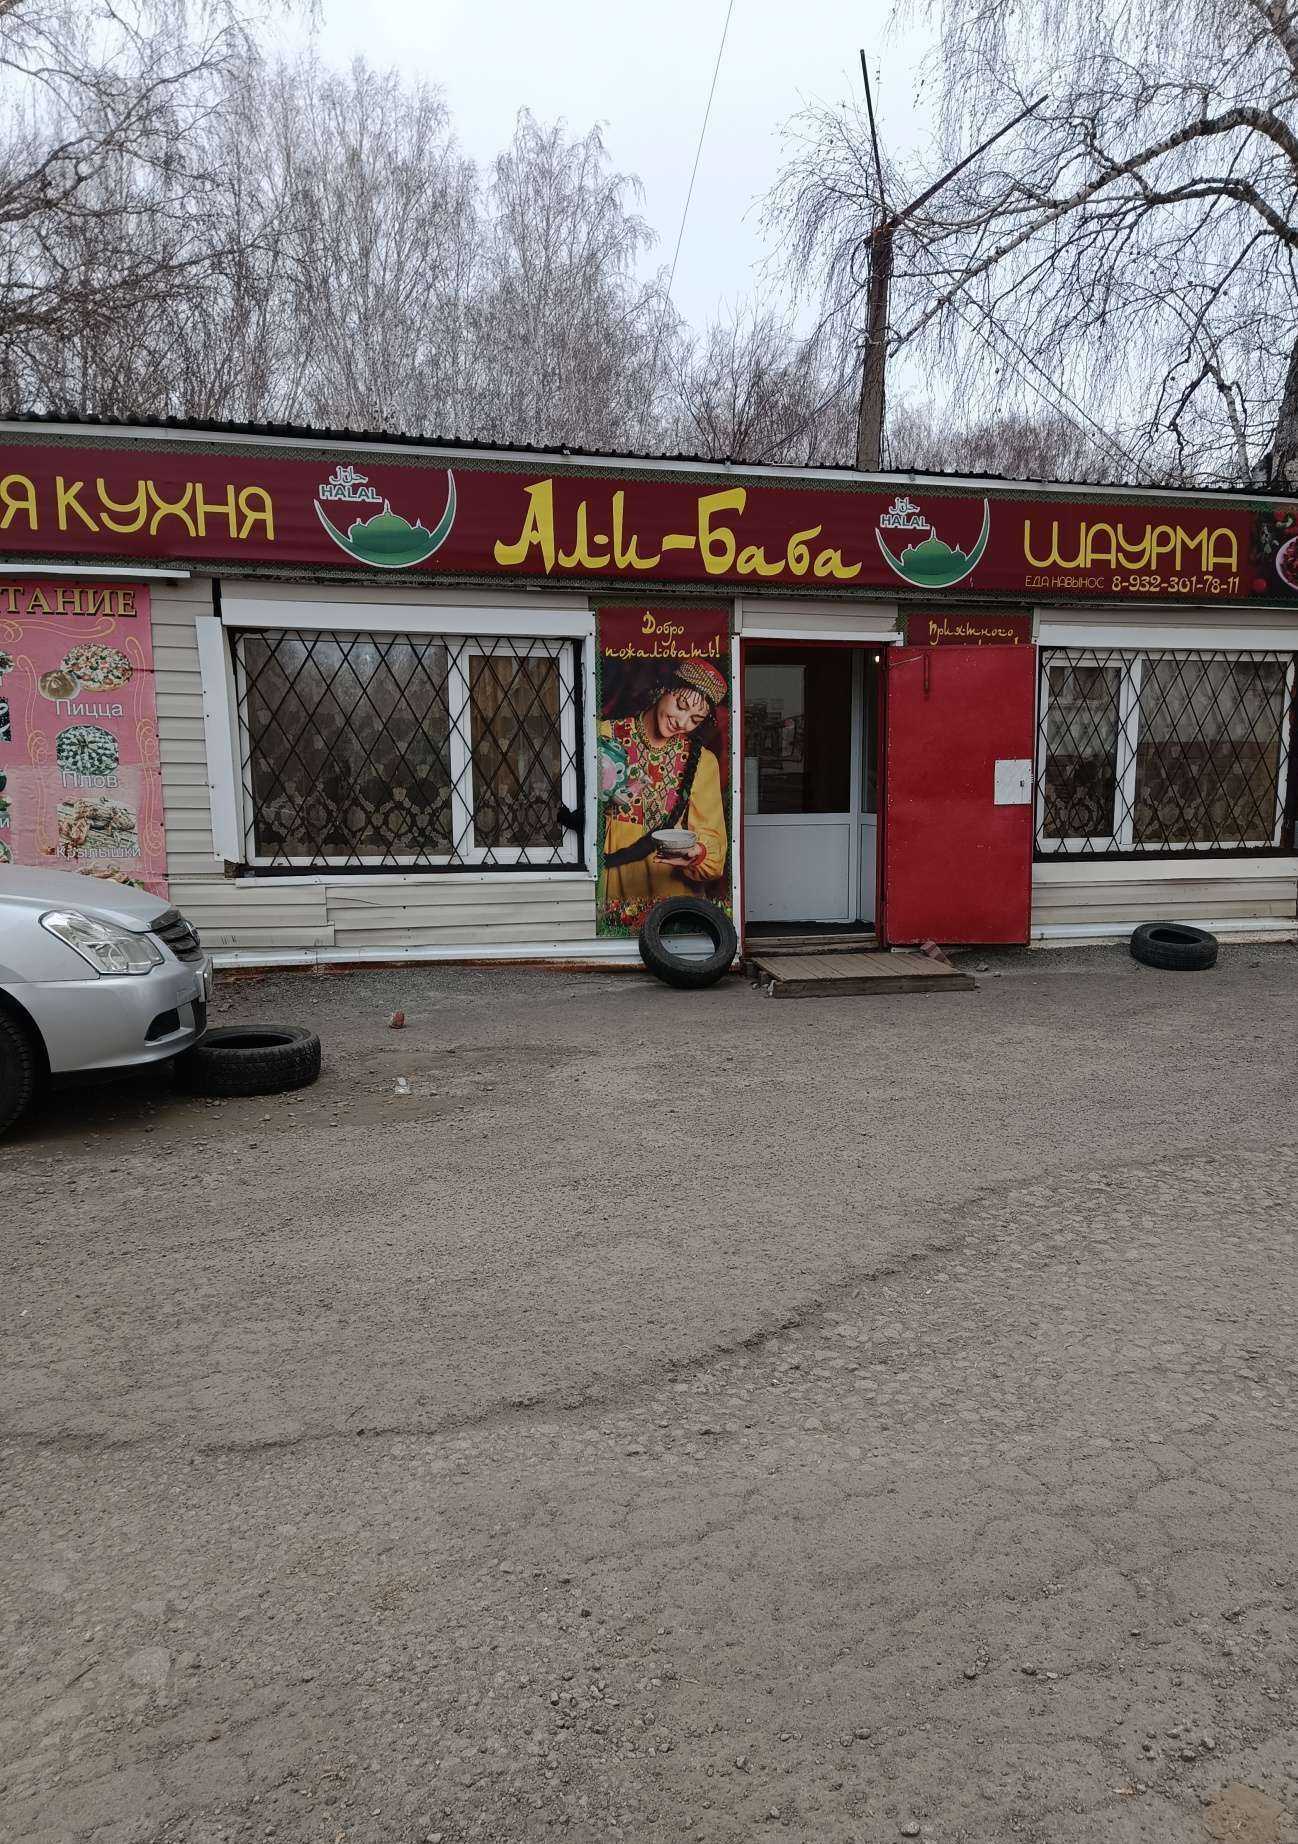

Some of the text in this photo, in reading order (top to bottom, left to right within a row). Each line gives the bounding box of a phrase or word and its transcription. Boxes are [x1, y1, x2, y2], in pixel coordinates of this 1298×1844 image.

[319, 484, 383, 503] HALAL
[55, 475, 276, 541] КУХНЯ
[493, 478, 863, 580] Али-Баба
[880, 513, 931, 530] HALAL
[1024, 519, 1238, 572] ШАУРМА
[1025, 575, 1050, 588] ЕДА
[1111, 574, 1240, 594] 8-932-301-78-11
[641, 610, 685, 646] Добро
[928, 618, 1014, 646] Приятного
[604, 634, 721, 660] пожаловать!
[55, 698, 124, 718] Пицца
[61, 769, 120, 789] Плов
